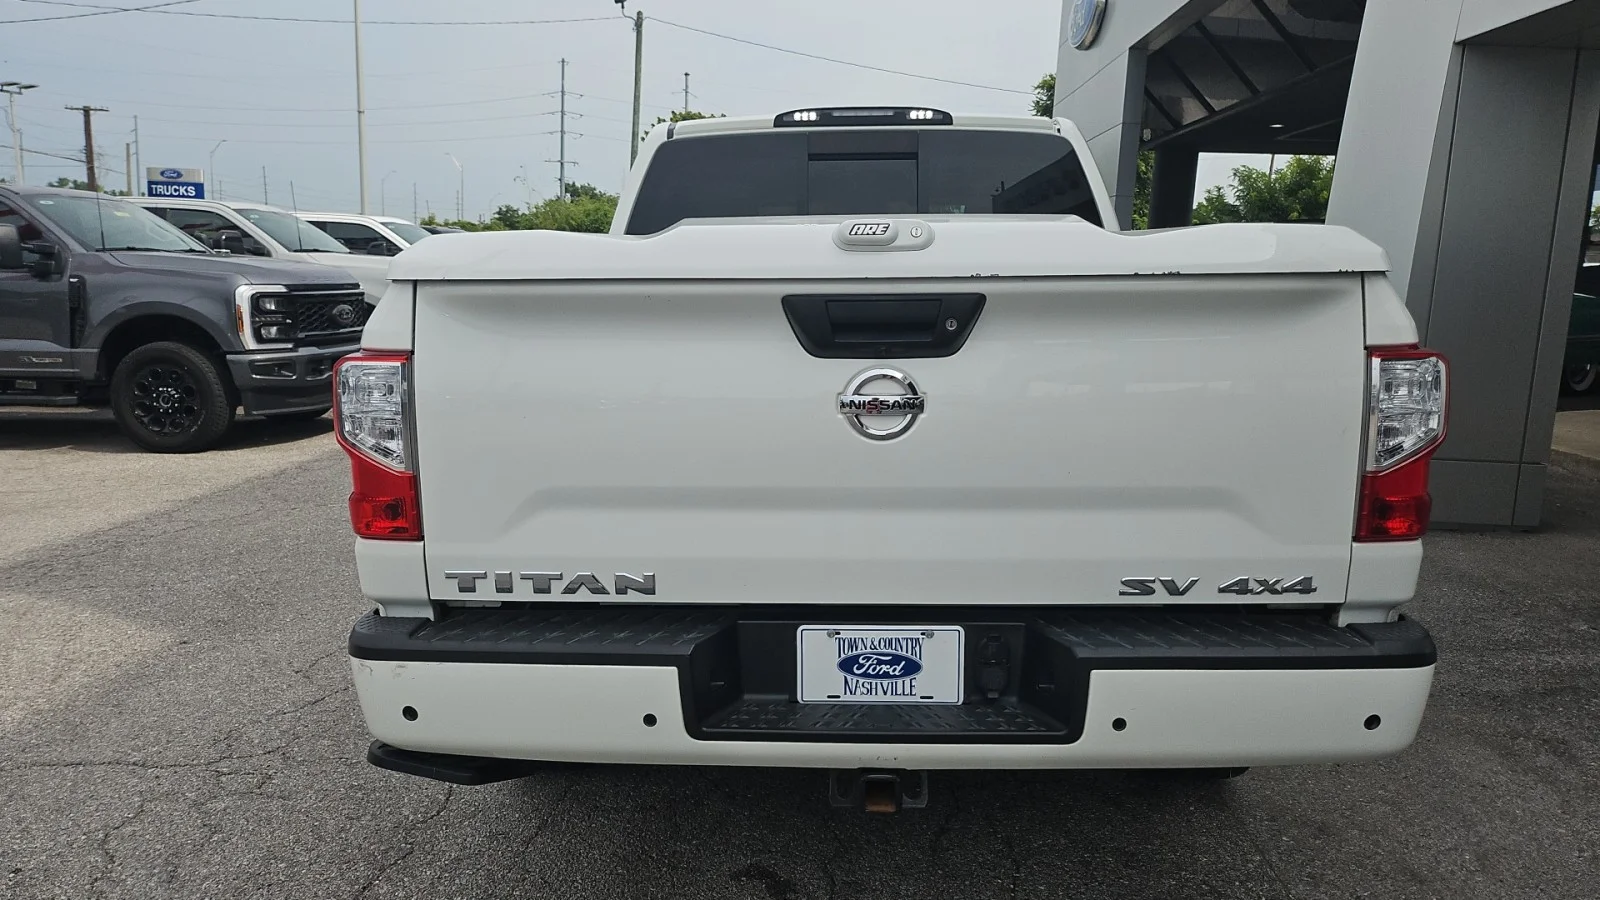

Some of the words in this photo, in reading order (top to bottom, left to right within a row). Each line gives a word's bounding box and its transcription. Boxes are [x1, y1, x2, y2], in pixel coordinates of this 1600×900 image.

[151, 185, 196, 196] TRUCKS
[849, 223, 890, 235] ARE
[849, 399, 916, 410] NISSAN
[444, 570, 656, 596] TITAN
[1118, 576, 1201, 597] SV
[835, 636, 867, 659] TOWN
[878, 636, 925, 661] COUNTRY
[853, 654, 906, 676] Ford
[844, 675, 916, 696] NASHVILLE
